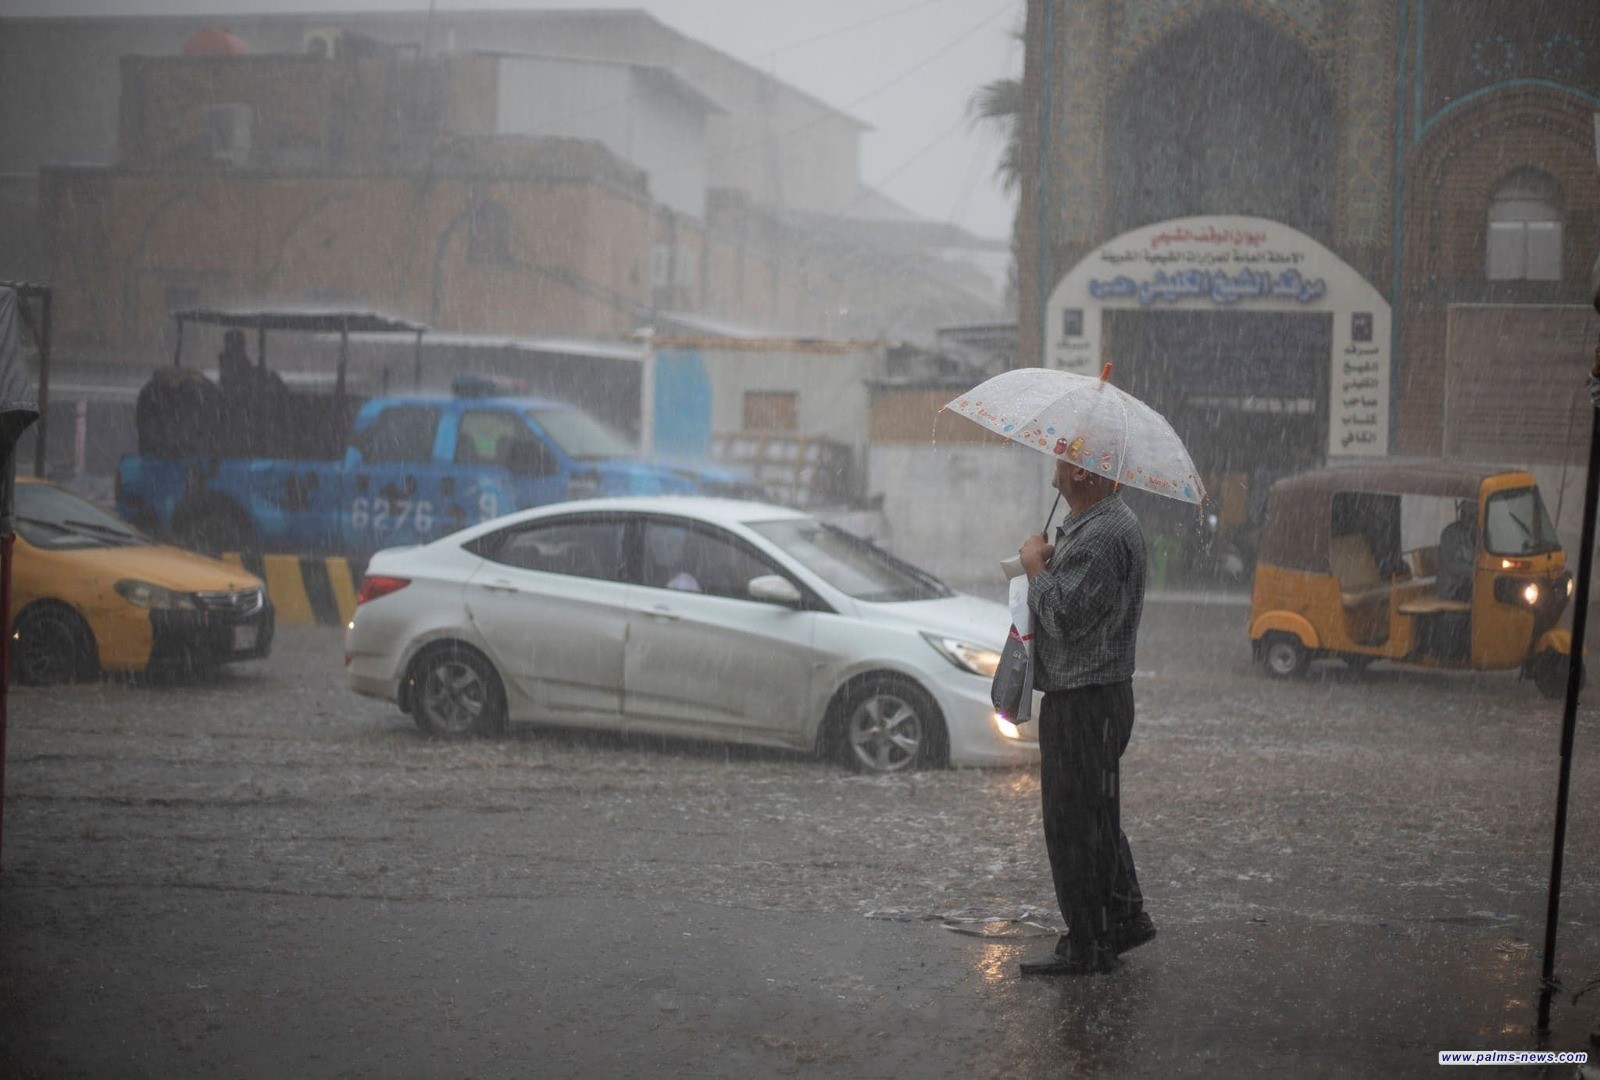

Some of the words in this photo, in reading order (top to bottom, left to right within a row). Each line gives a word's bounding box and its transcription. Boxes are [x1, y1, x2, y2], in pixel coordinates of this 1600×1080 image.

[1139, 268, 1210, 305] الكليني
[1211, 266, 1271, 305] الشيخ
[1272, 268, 1327, 302] مرقد
[352, 497, 433, 531] 6276
